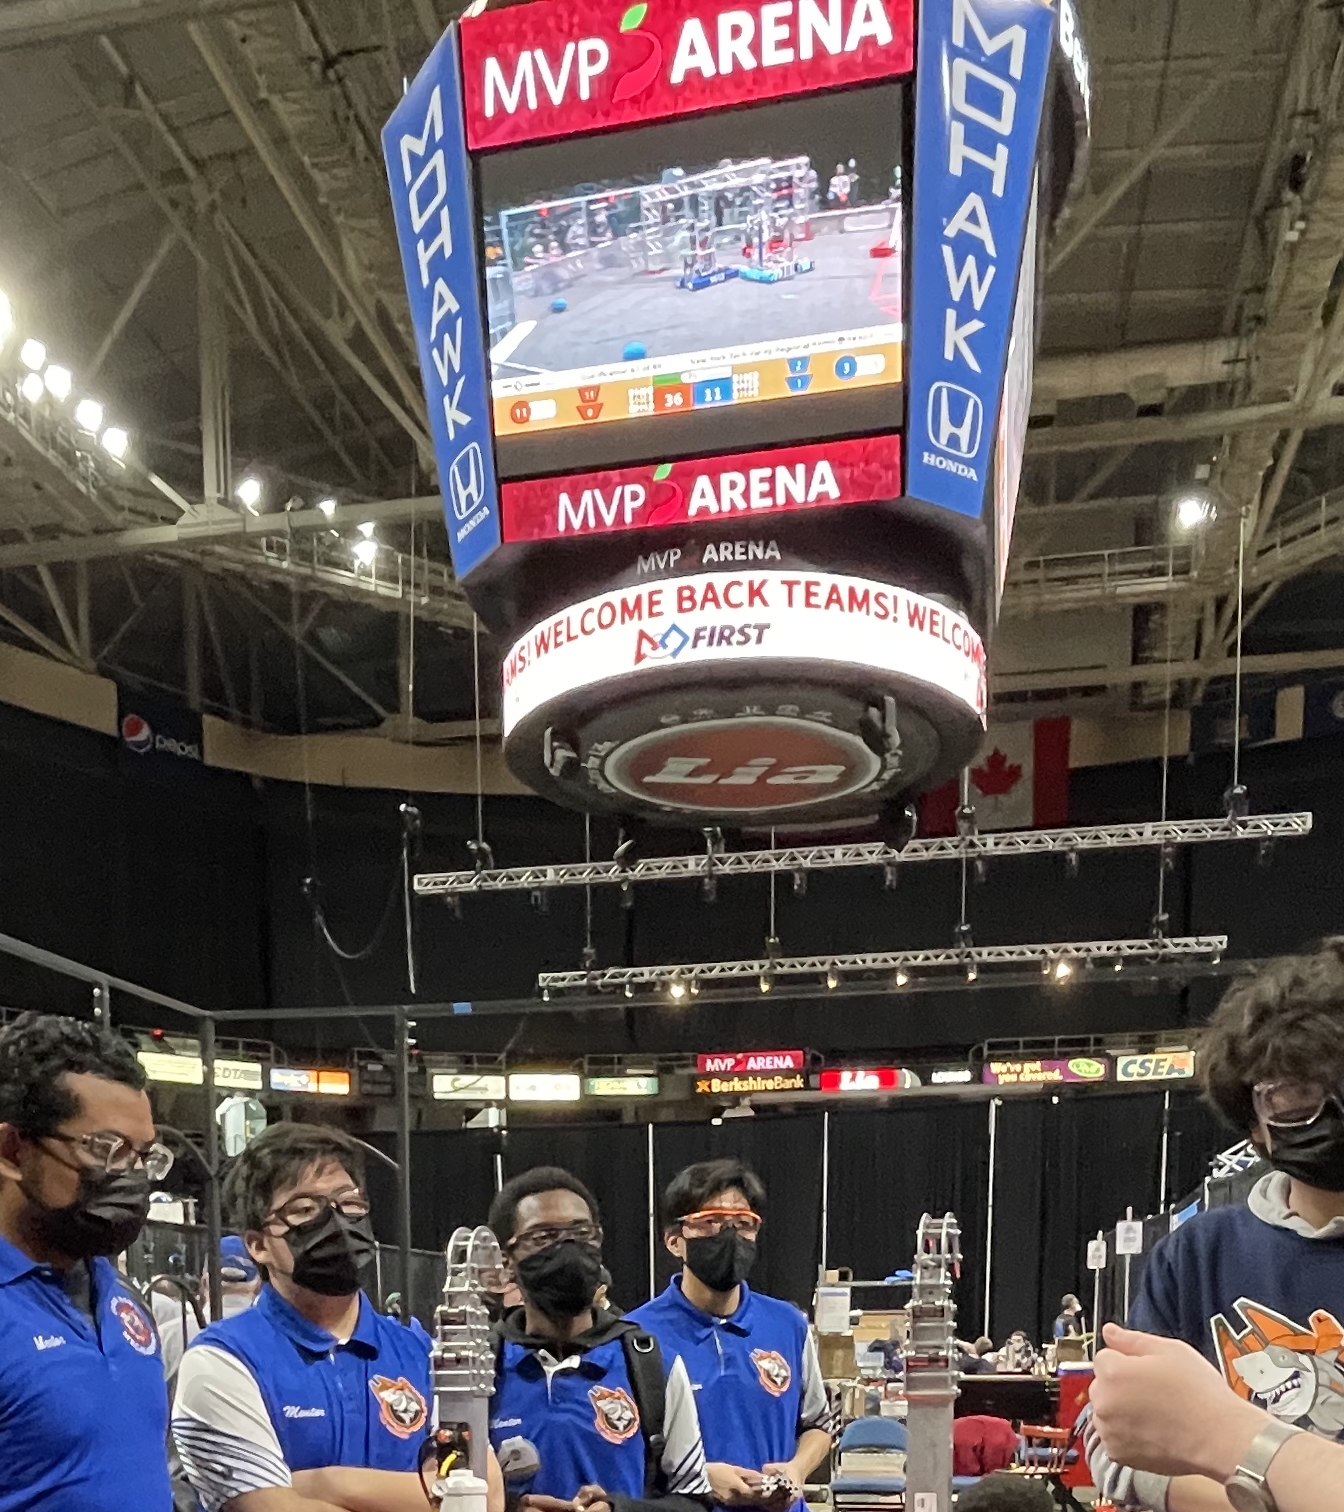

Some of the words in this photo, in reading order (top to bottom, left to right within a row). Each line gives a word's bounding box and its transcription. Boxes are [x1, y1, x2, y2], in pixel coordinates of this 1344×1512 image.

[482, 37, 610, 119] MVP
[669, 0, 894, 85] ARENA
[942, 0, 1028, 374] MOHAWK
[400, 86, 472, 441] MOHAWK
[664, 391, 684, 408] 36
[704, 386, 723, 402] 11
[922, 451, 979, 482] HONDA
[557, 488, 647, 533] MVP
[687, 460, 841, 517] ARENA
[457, 505, 490, 544] HONDA
[636, 547, 683, 576] MVP
[701, 540, 782, 565] ARENA
[534, 588, 664, 660] WELCOME
[676, 578, 770, 614] BACK
[780, 579, 899, 624] TEAMS!
[691, 622, 771, 649] FIRST
[641, 757, 846, 786] Lia
[705, 1057, 735, 1072] MVP
[746, 1055, 795, 1070] ARENA
[989, 1061, 1022, 1074] We've
[998, 1071, 1018, 1085] you
[1121, 1058, 1186, 1078] CSEA
[710, 1073, 805, 1093] BerkshireBank
